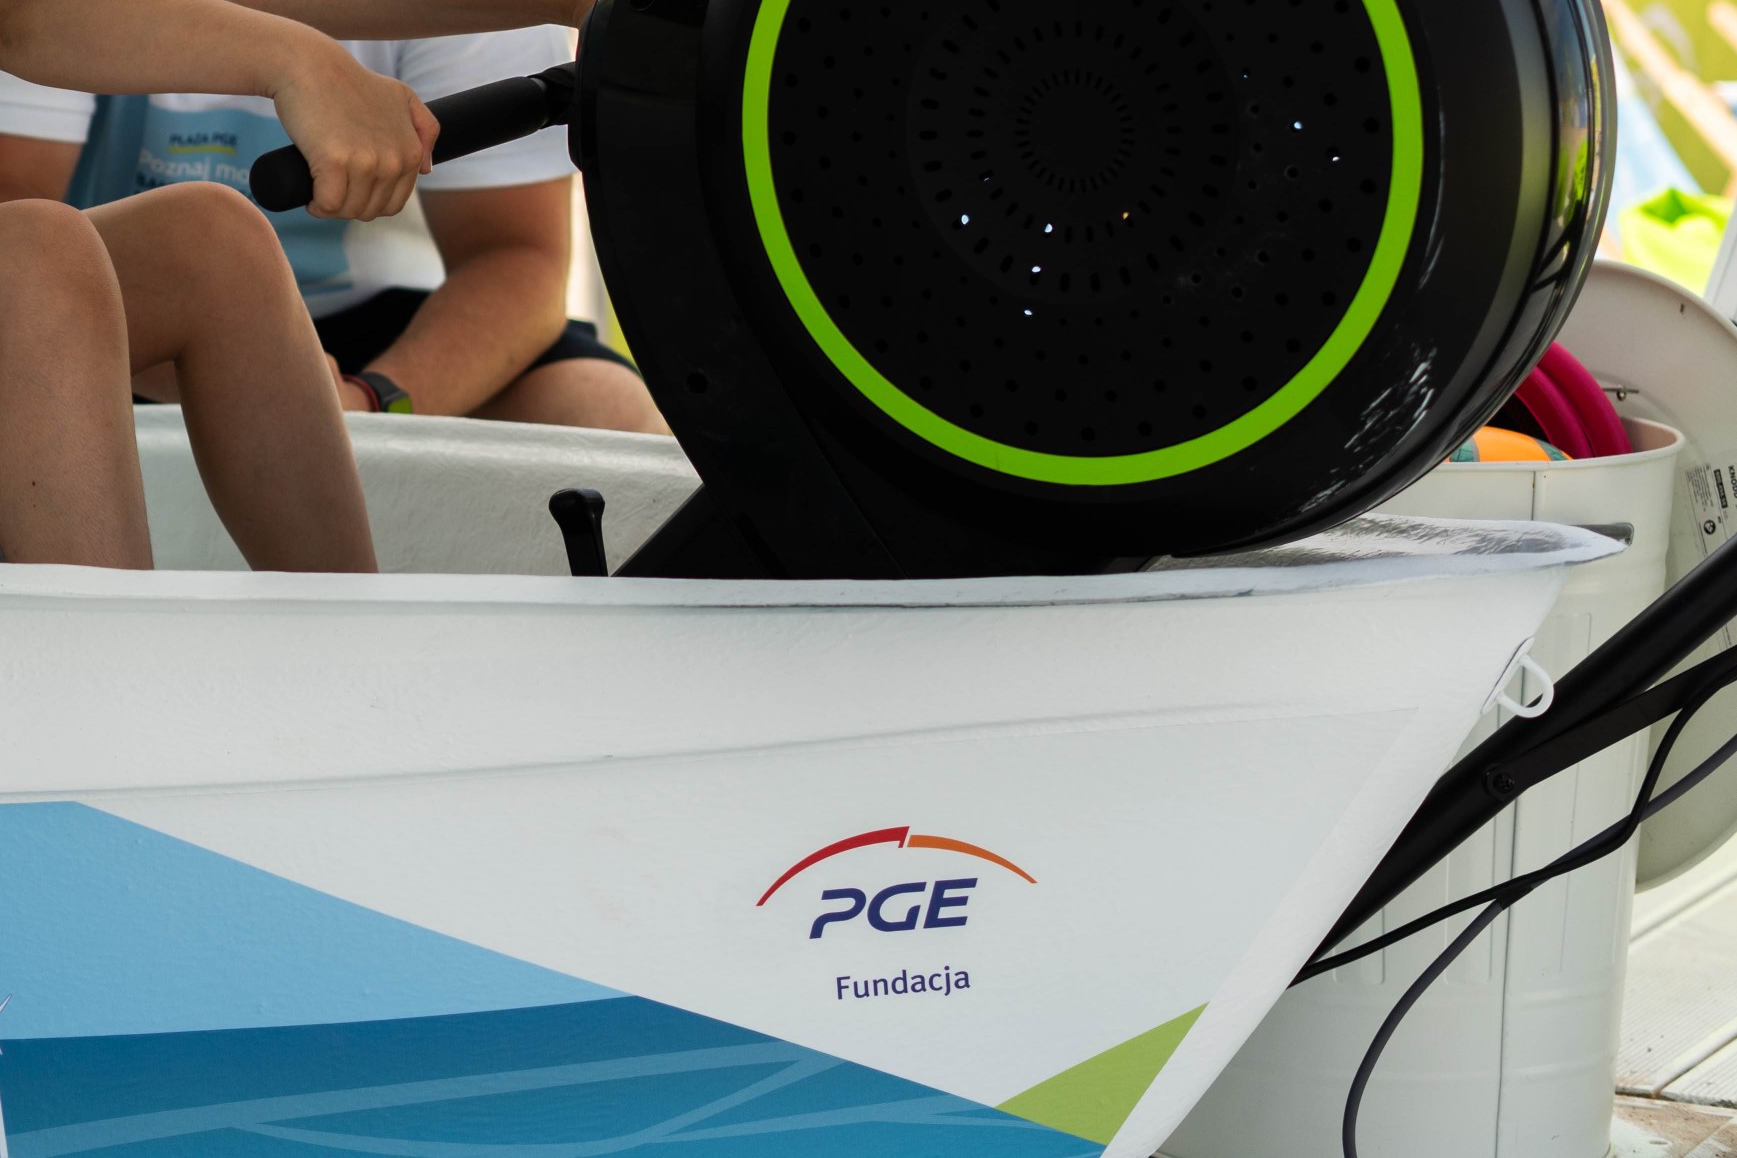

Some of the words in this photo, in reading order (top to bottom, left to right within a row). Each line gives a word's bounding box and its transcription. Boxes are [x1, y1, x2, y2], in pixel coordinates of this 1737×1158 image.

[140, 149, 210, 182] Poznaj
[216, 163, 250, 183] mo
[809, 877, 978, 939] PGE
[836, 965, 971, 1000] Fundacja
